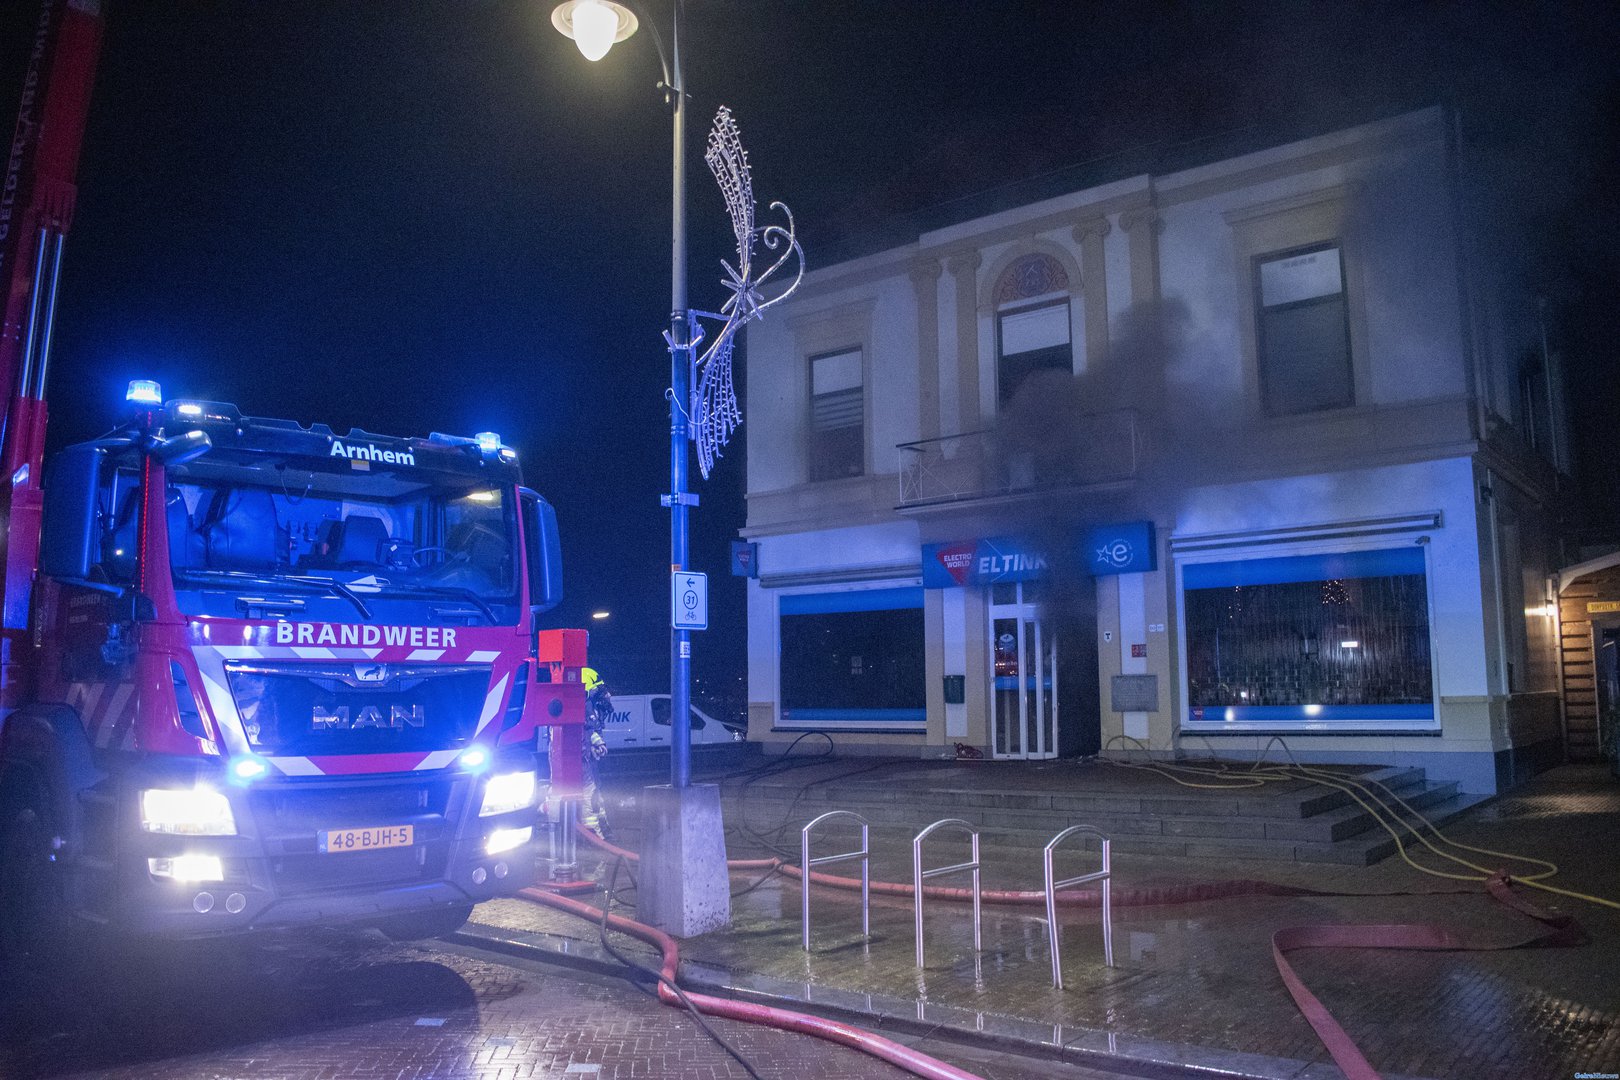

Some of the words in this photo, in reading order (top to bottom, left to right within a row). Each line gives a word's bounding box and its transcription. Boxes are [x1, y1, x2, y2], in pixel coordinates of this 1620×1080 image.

[330, 440, 415, 466] Arnhem
[943, 553, 972, 562] ELECTRO
[946, 560, 970, 569] WORLD
[978, 554, 1048, 574] ELTINK
[686, 595, 695, 605] 31
[276, 622, 457, 648] BRANDWEER
[312, 704, 425, 731] MAN
[607, 711, 631, 723] INK
[333, 828, 408, 849] 48-BJH-5
